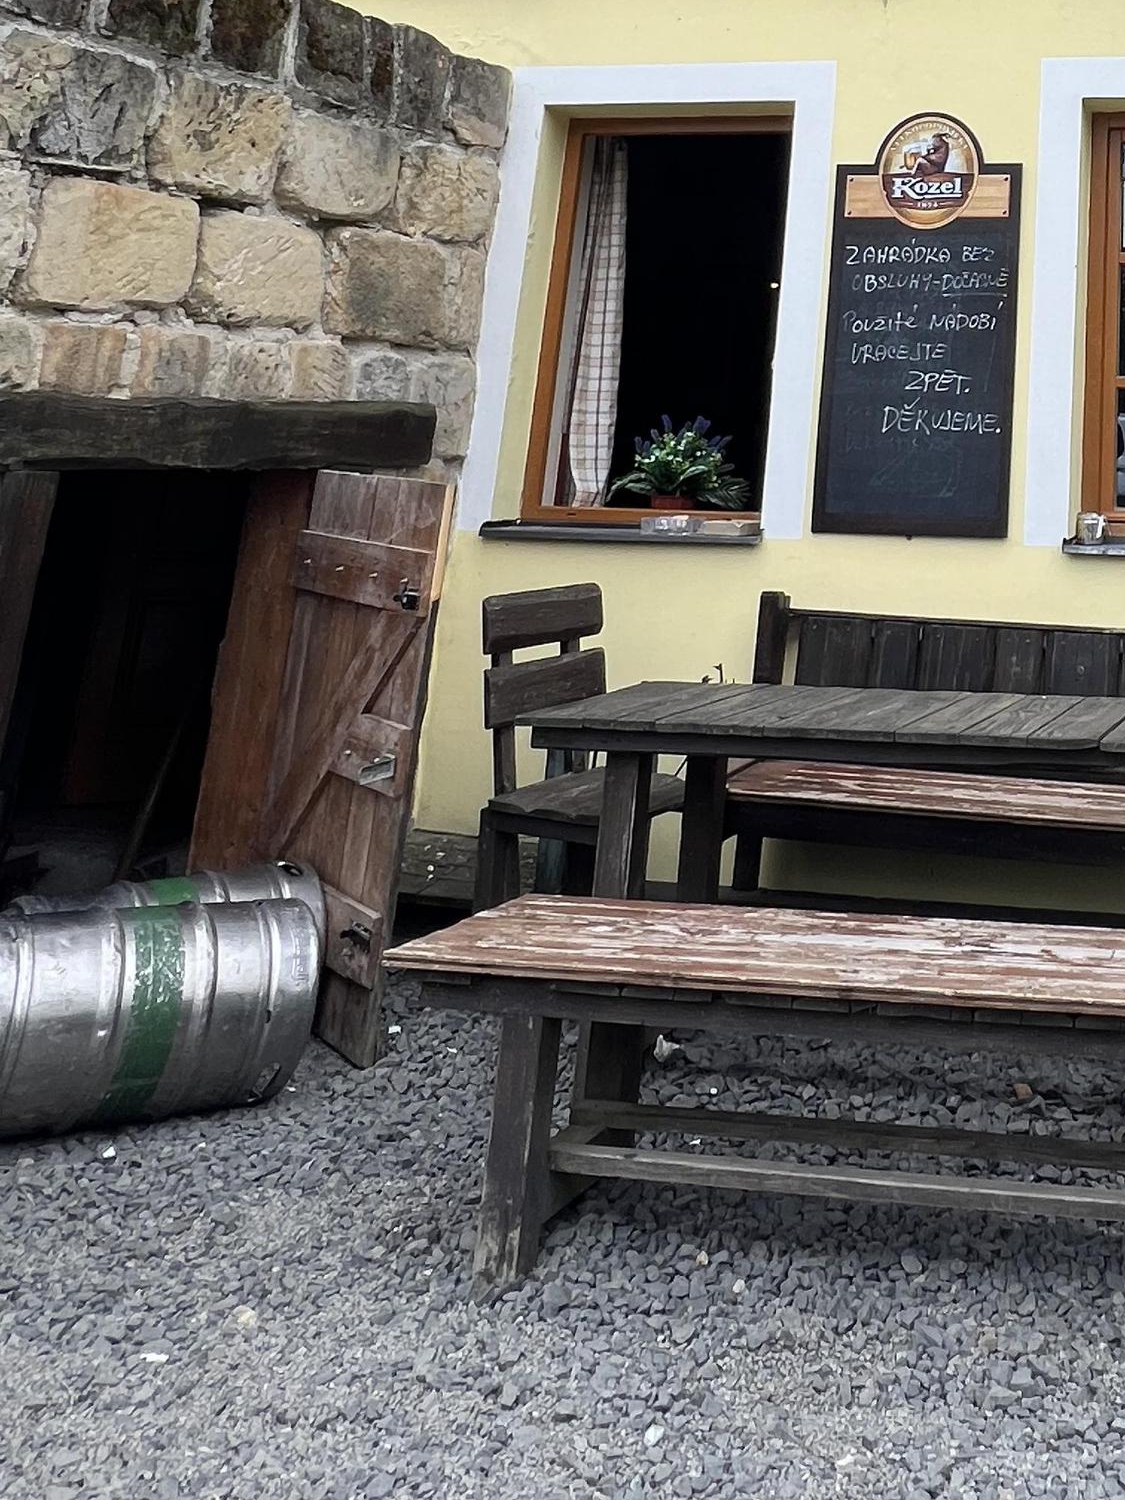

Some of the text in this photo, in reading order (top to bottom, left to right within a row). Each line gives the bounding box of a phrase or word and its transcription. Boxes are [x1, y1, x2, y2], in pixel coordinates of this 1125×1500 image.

[891, 177, 963, 200] Kozel
[845, 238, 995, 265] ZAHRÁDKA BEZ
[929, 301, 1004, 331] NÁDOBÍ
[851, 342, 949, 364] VRACEJTE
[881, 397, 1002, 435] DĚKUJEME.
